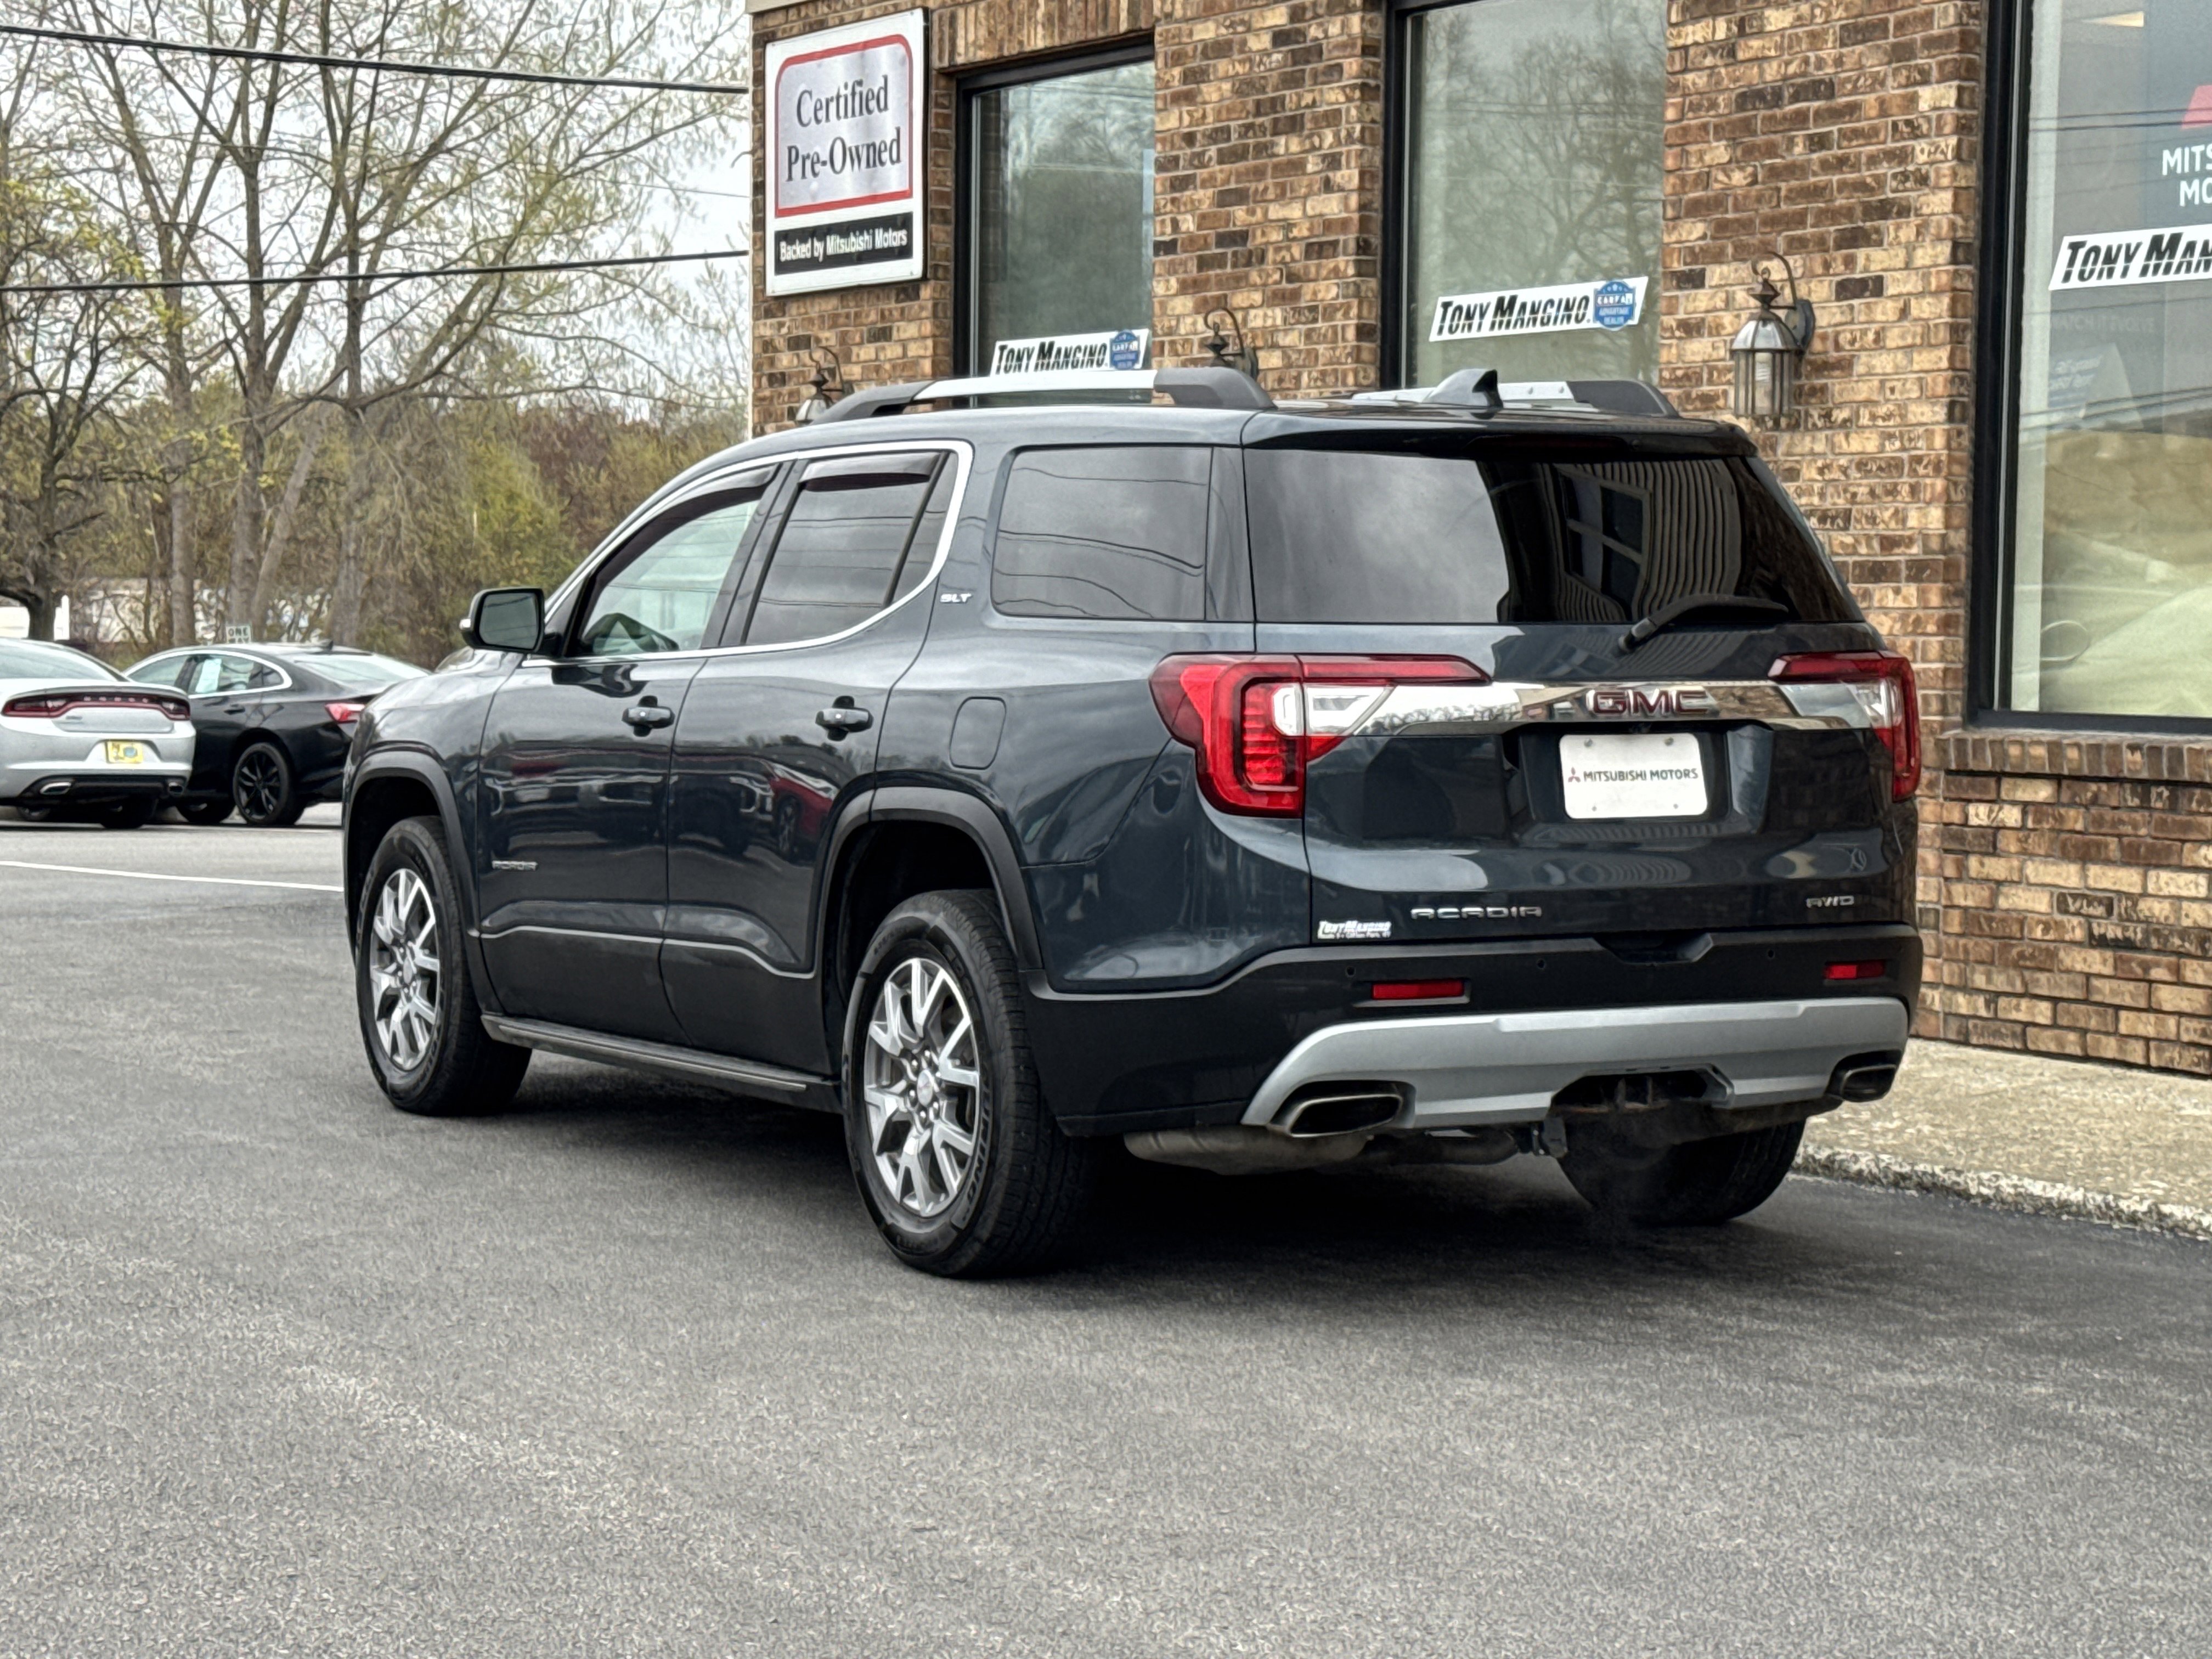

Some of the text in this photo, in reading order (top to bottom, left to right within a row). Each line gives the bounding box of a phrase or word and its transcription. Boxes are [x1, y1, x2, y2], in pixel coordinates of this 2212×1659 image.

[797, 74, 889, 127] Certified
[786, 126, 901, 182] Pre-Owned
[780, 227, 907, 263] Backed by Mitsubishi Motors
[2061, 240, 2143, 284] TONY
[1436, 295, 1590, 336] TONY MANGINO
[995, 341, 1108, 375] TONY MANGINO
[940, 593, 972, 603] SLT
[228, 628, 248, 636] ONE
[1587, 689, 1711, 715] GMC
[1583, 768, 1699, 782] MITSUBISHI MOTORS
[1410, 906, 1542, 920] ACADIA
[1806, 895, 1855, 908] AWD
